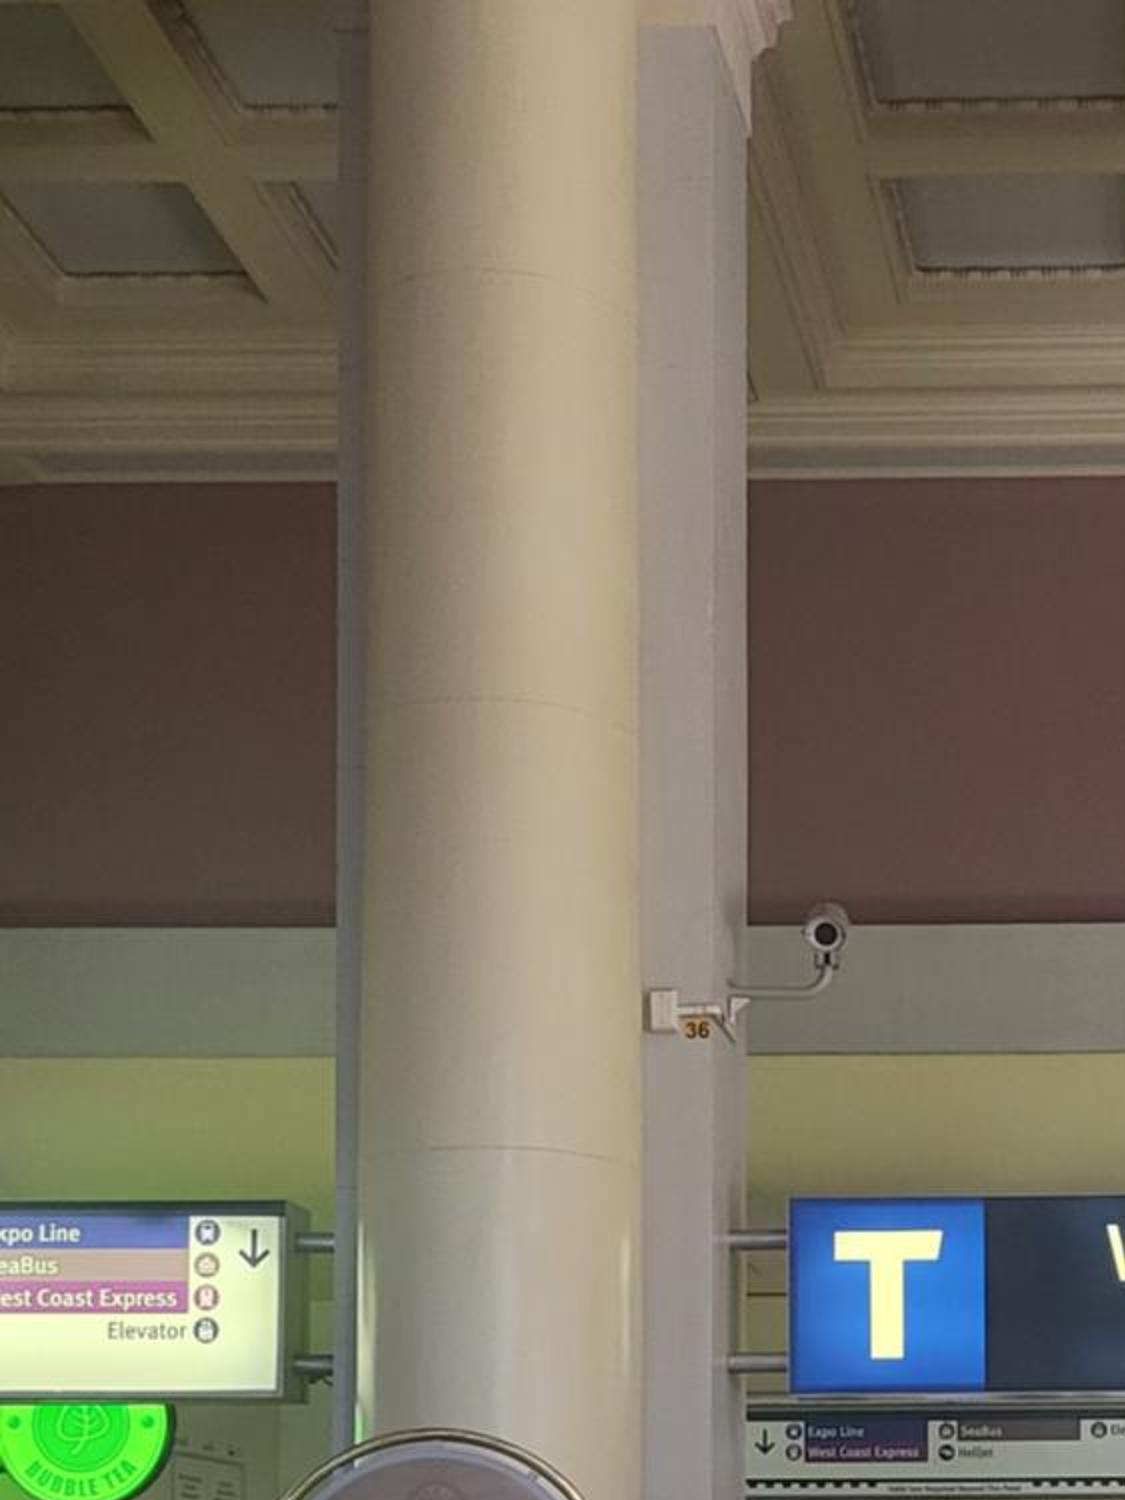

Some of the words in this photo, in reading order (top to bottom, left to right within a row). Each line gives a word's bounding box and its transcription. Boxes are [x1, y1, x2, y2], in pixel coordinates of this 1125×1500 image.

[684, 1021, 710, 1040] 36
[38, 1222, 81, 1243] Line
[37, 1286, 94, 1307] Coast
[100, 1287, 178, 1310] Express
[834, 1229, 943, 1359] T
[107, 1320, 187, 1341] Elevator
[807, 1426, 837, 1439] Expo
[840, 1426, 865, 1438] Line
[839, 1446, 873, 1458] Coast
[875, 1446, 920, 1459] Express
[24, 1460, 100, 1497] BUBBLE
[103, 1459, 138, 1490] TEA
